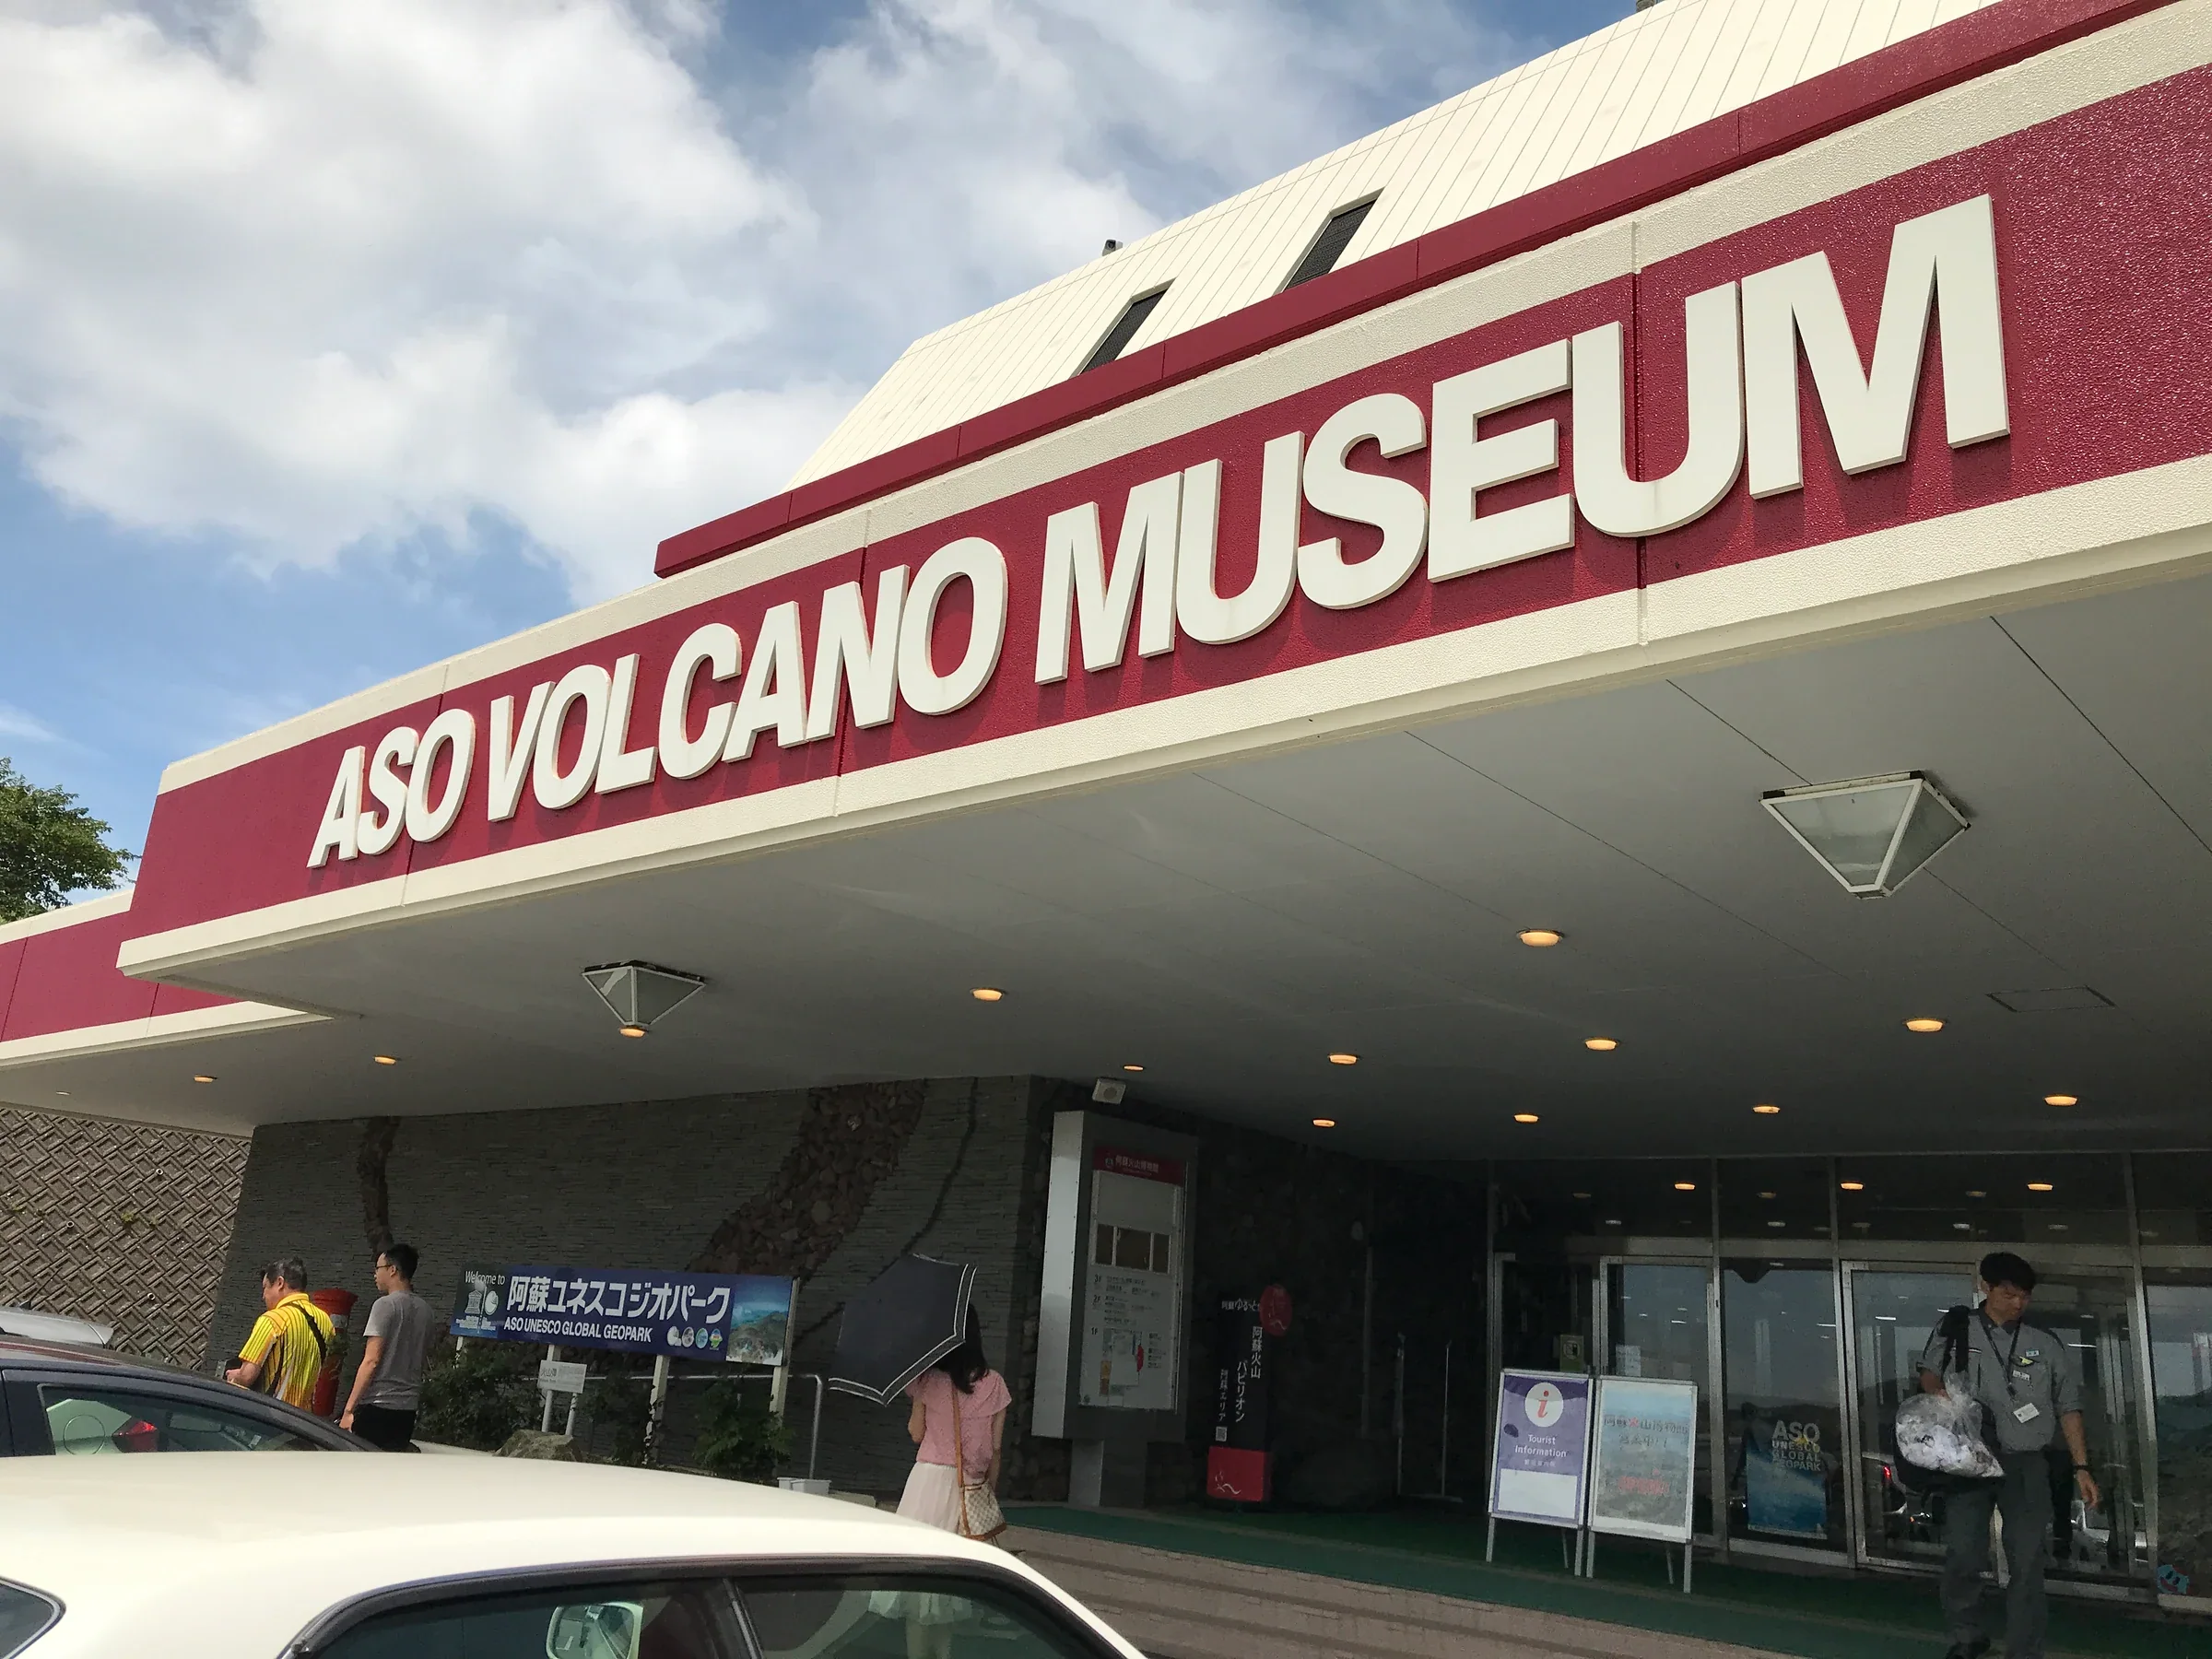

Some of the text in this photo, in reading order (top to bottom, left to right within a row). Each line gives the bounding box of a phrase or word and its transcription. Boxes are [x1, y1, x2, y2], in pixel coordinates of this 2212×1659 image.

[307, 194, 2011, 869] ASO VOLCANO MUSEUM
[465, 1271, 505, 1286] Welcome to
[507, 1276, 731, 1324] 阿蘇ユネスコジオパーク
[503, 1316, 653, 1344] ASO UNESCO GLOBAL GEOPARK
[1251, 1326, 1263, 1380] 阿蘇火山
[1235, 1359, 1248, 1423] パビリオン
[1528, 1434, 1556, 1445] Tourist
[1771, 1419, 1821, 1442] ASO
[1514, 1444, 1567, 1458] Information
[1771, 1440, 1821, 1453] UNESCO
[1771, 1451, 1821, 1463] GLOBAL
